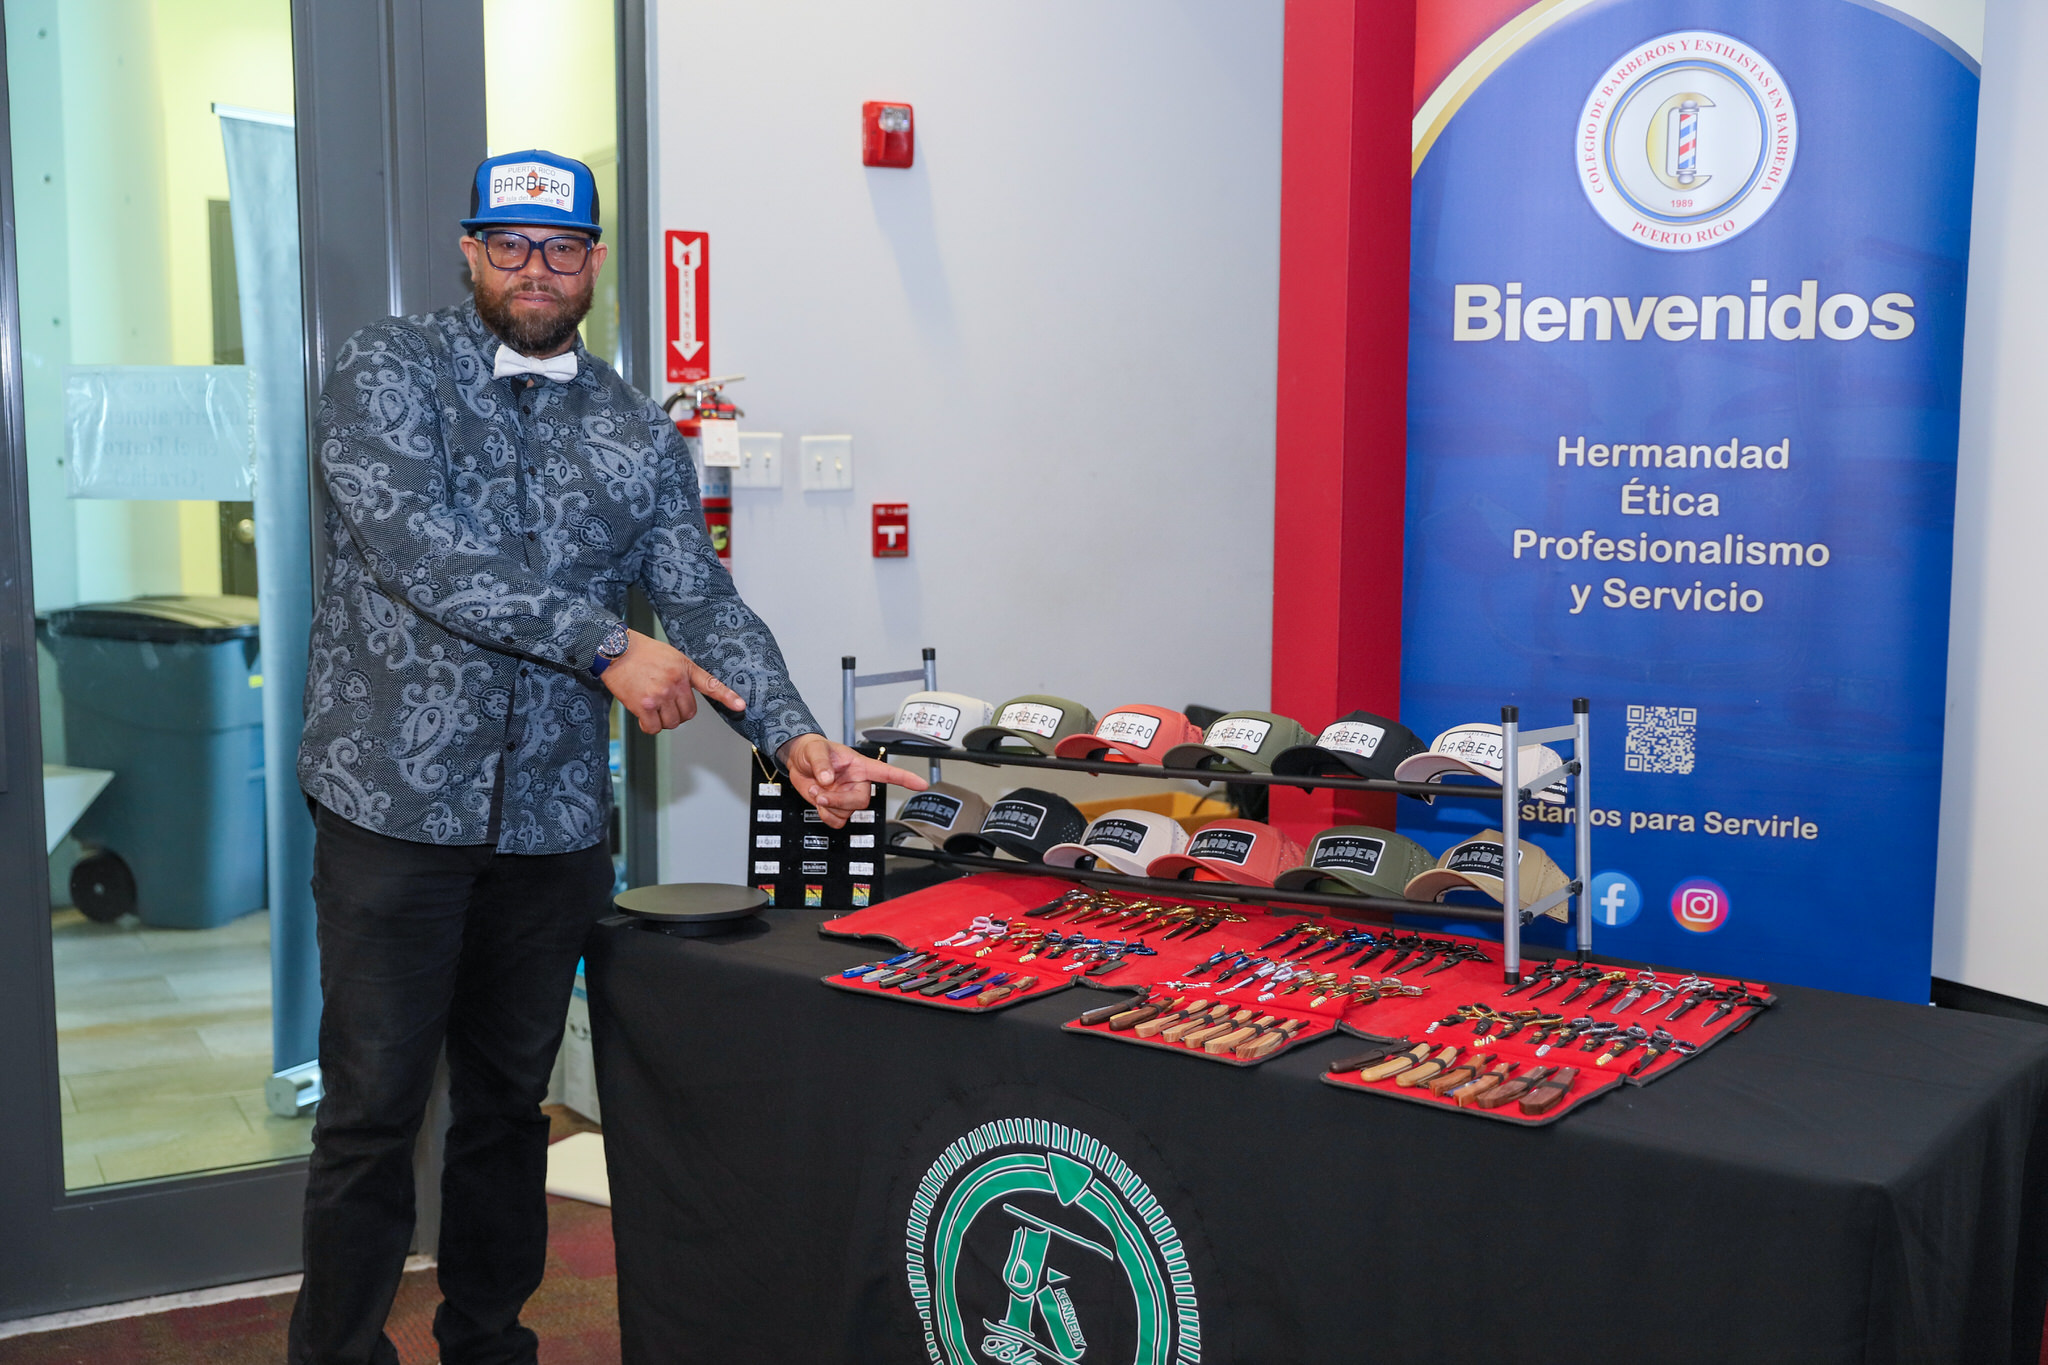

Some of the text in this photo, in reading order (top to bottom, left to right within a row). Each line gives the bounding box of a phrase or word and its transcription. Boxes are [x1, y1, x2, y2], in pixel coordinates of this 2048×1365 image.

[1680, 39, 1690, 51] Y
[1602, 42, 1676, 97] BARBEROS
[1694, 39, 1774, 88] ESTILISTAS
[1589, 97, 1607, 120] DE
[1767, 88, 1785, 109] EN
[1583, 122, 1605, 194] COLEGIO
[508, 165, 556, 177] PUERTO RICO
[494, 175, 570, 198] BARBERO
[1671, 199, 1694, 208] 1989
[1631, 219, 1735, 245] PUERTO RICO
[1453, 279, 1916, 342] Bienvenidos
[1557, 435, 1790, 470] Hermandad
[1620, 477, 1720, 517] Ética
[1512, 528, 1831, 567] Profesionalismo
[1569, 577, 1764, 615] y Servicio
[989, 809, 1039, 828] BARBER
[1629, 811, 1696, 834] para
[1703, 811, 1819, 840] Servirle
[1089, 826, 1143, 844] BARBER
[1191, 838, 1249, 854] BARBER
[1316, 845, 1379, 862] BARBER
[1450, 850, 1504, 868] BARBE
[1054, 1287, 1088, 1346] KENNEDY
